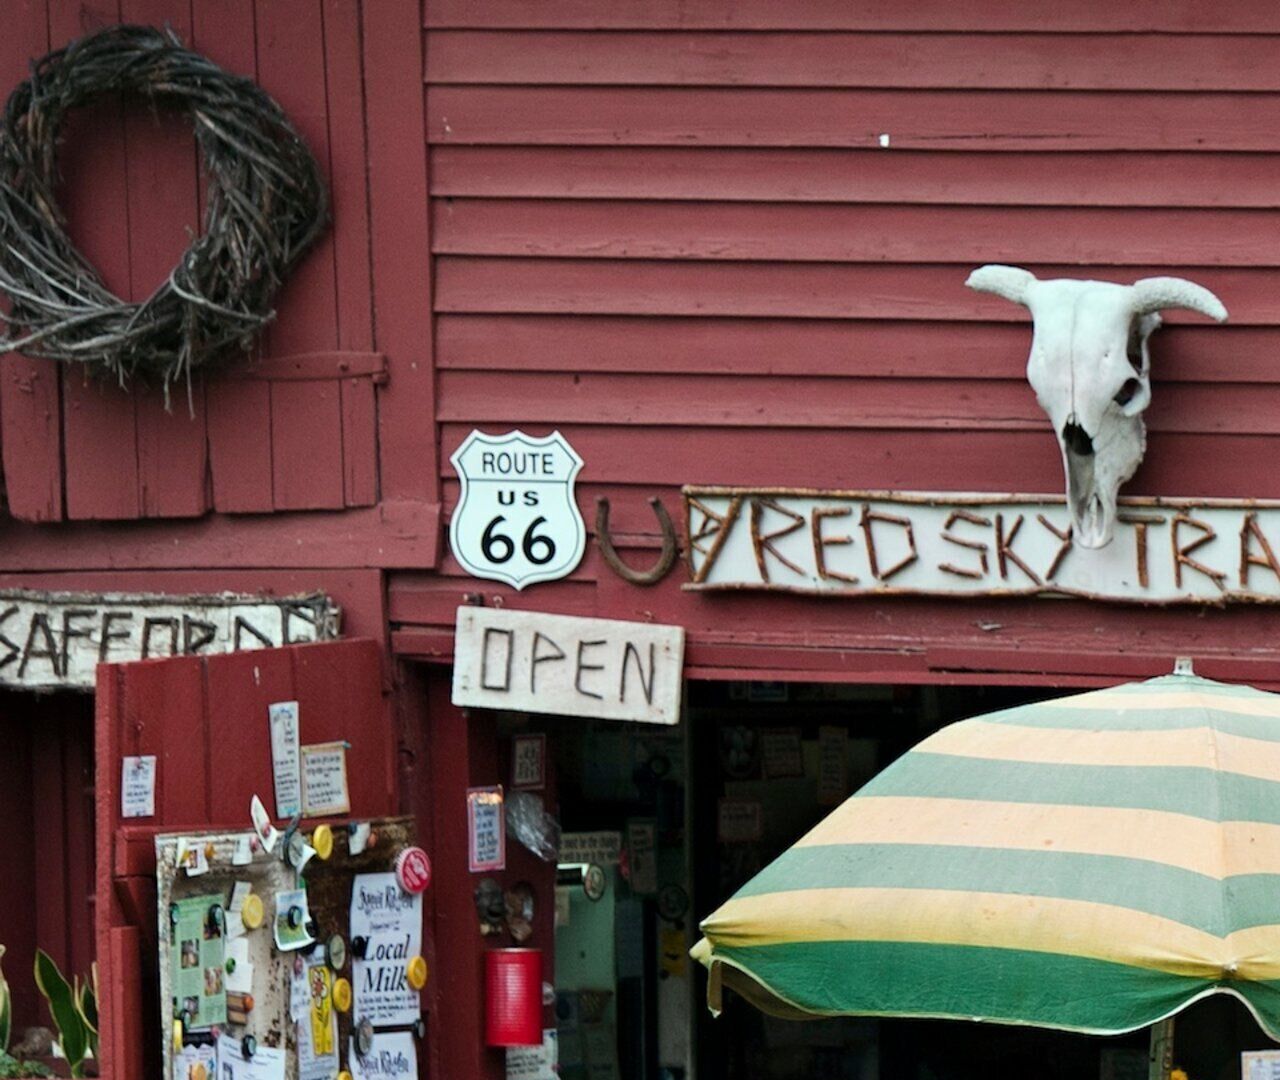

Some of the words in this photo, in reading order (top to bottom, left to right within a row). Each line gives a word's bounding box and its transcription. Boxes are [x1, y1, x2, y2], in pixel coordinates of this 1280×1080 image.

[482, 452, 554, 474] ROUTE
[497, 490, 539, 506] US
[481, 516, 556, 565] 66
[750, 499, 917, 583] RED
[939, 509, 1073, 586] SKY
[481, 627, 654, 706] OPEN
[363, 934, 410, 961] Local
[363, 966, 408, 993] Milk
